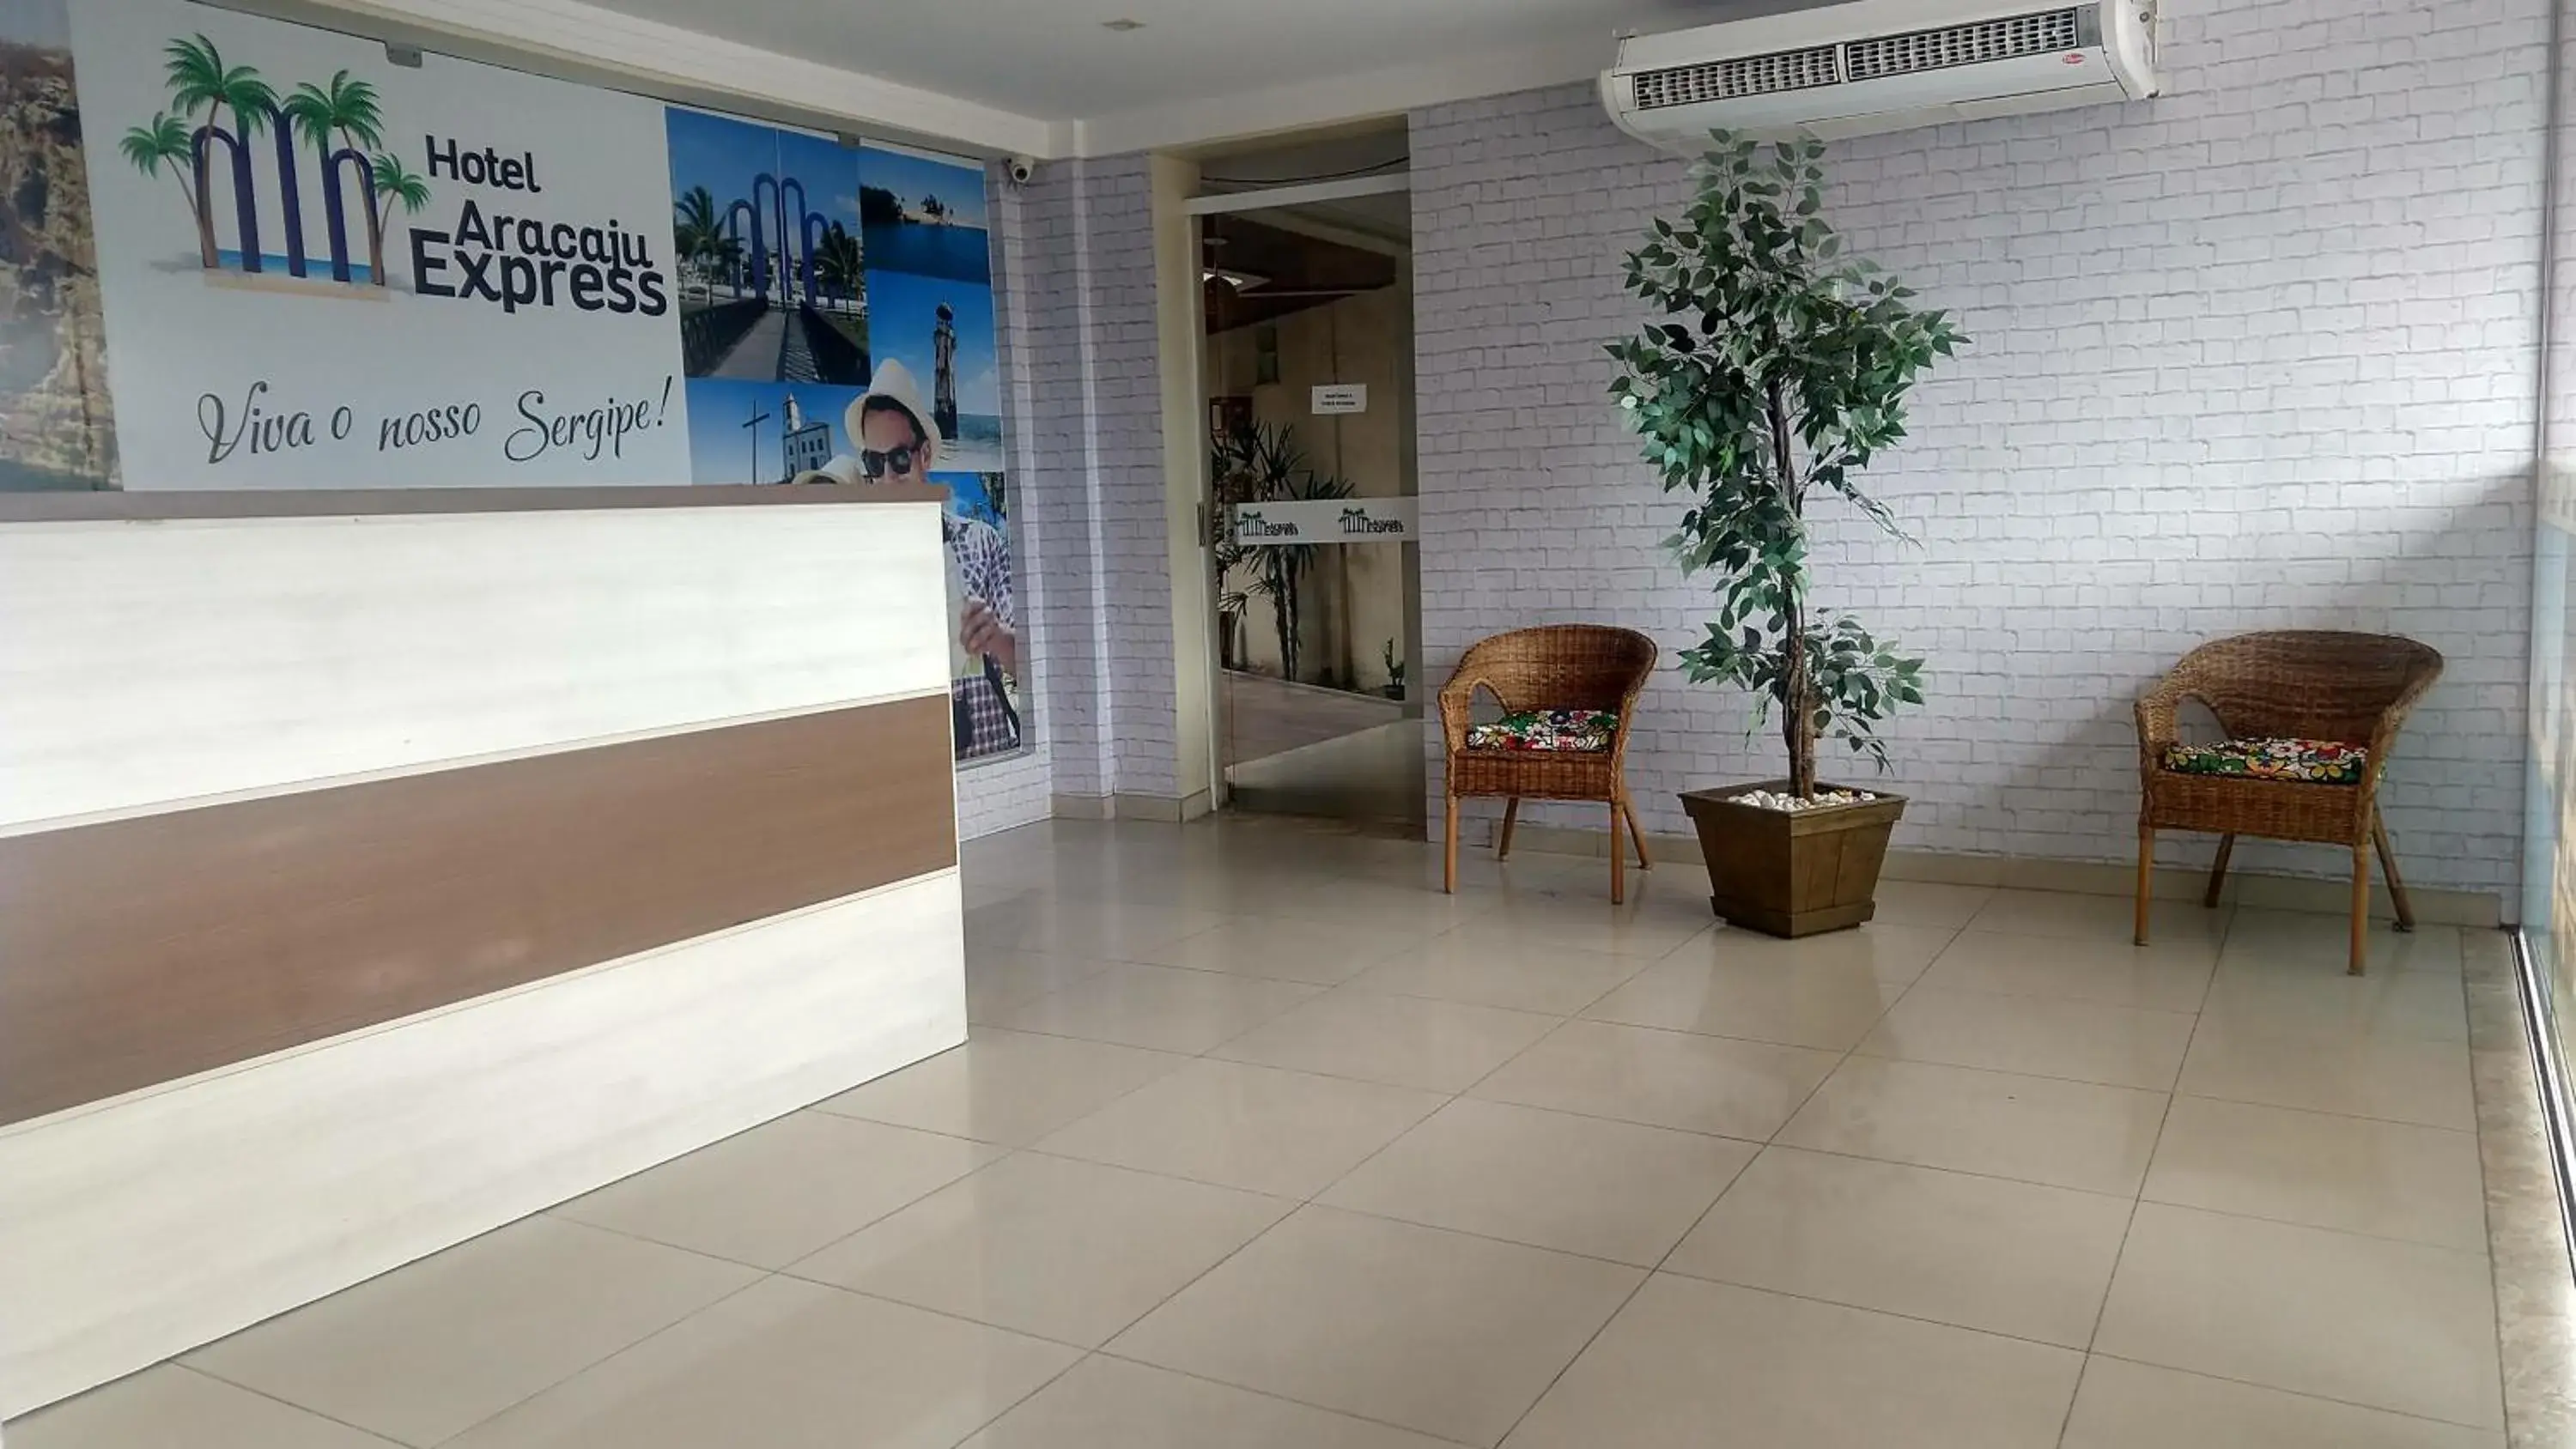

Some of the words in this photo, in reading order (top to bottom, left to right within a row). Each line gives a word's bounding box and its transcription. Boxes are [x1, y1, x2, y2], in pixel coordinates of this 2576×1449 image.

[426, 134, 541, 193] Hotel
[409, 227, 667, 317] Express
[455, 199, 654, 270] Aracaju
[197, 380, 315, 464] Viva
[330, 405, 352, 440] o
[379, 403, 482, 451] nosso
[505, 376, 672, 461] Sergipe!
